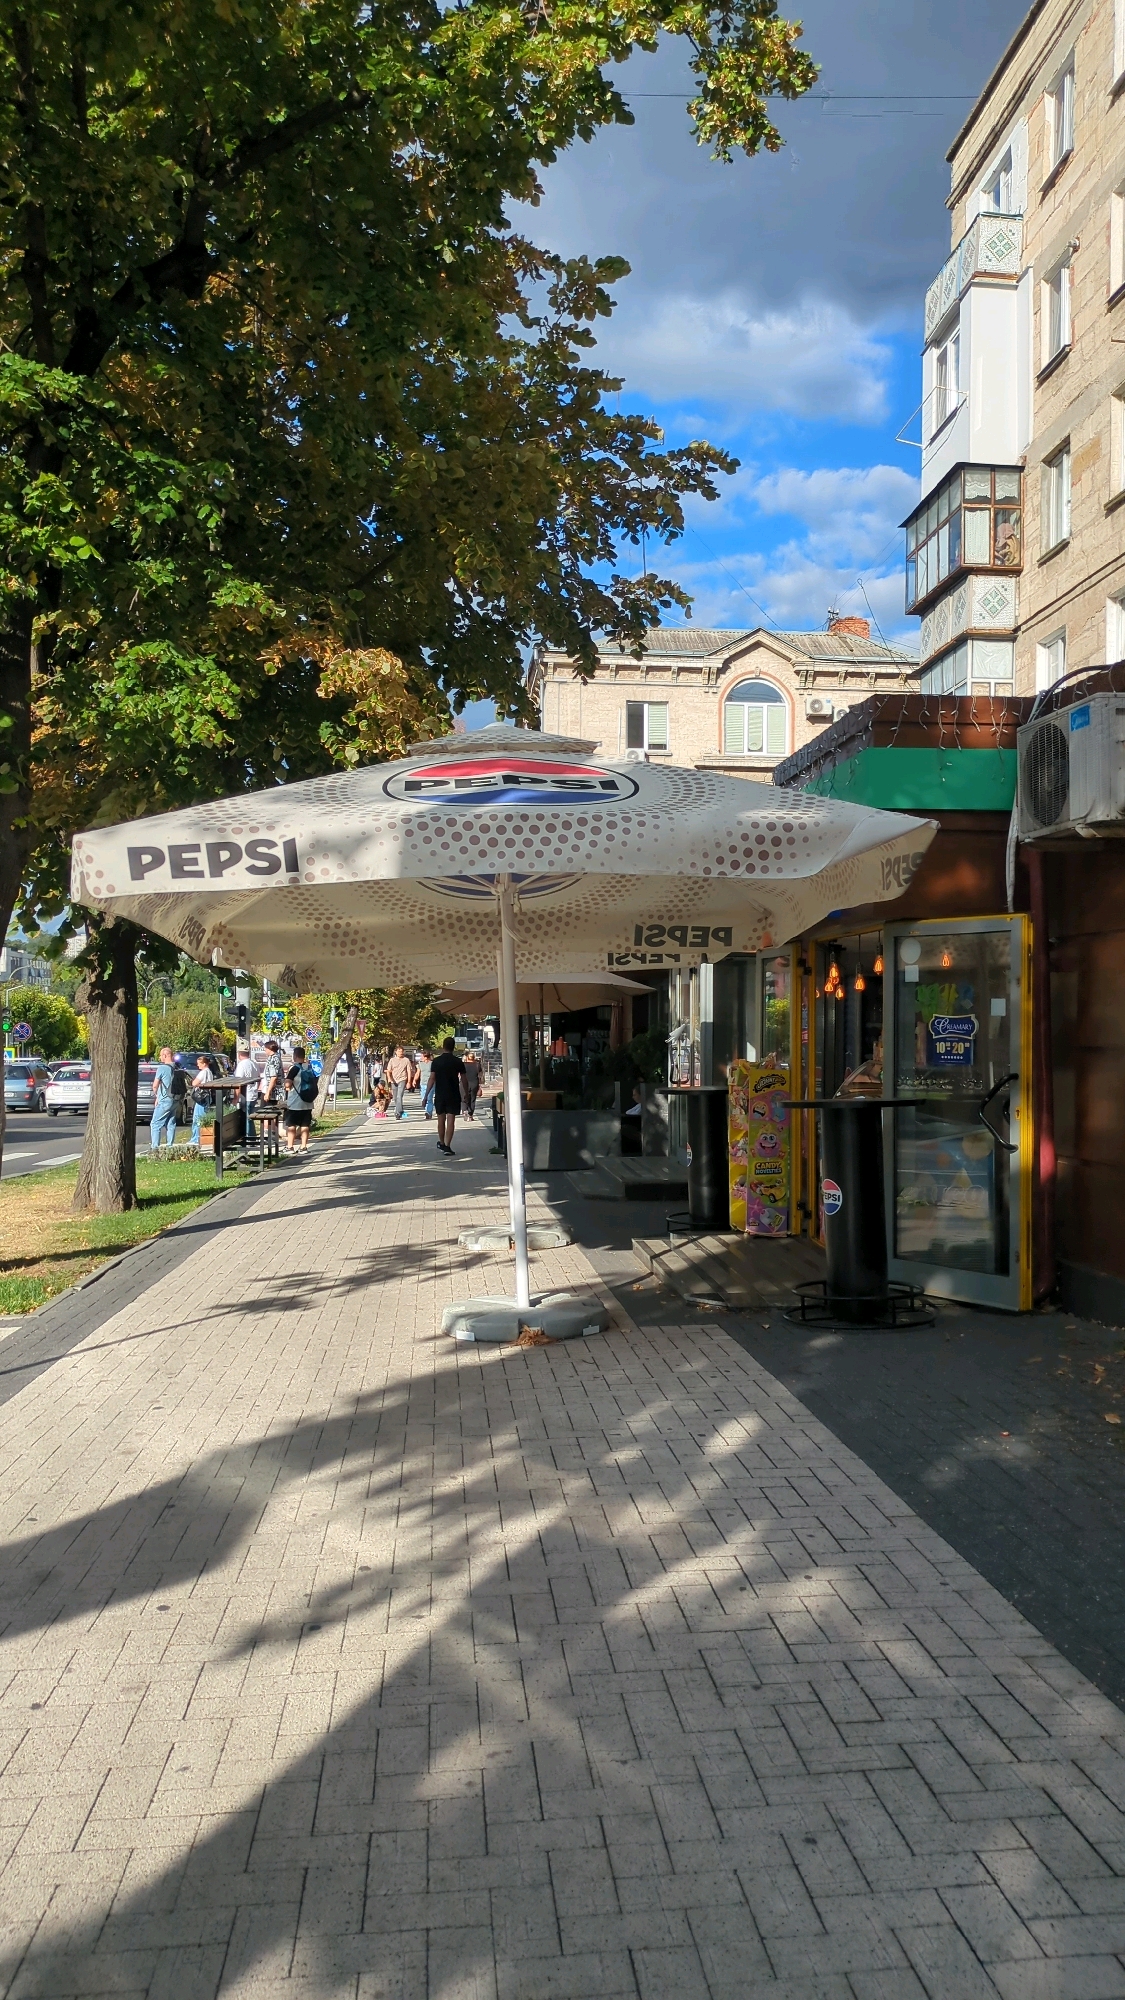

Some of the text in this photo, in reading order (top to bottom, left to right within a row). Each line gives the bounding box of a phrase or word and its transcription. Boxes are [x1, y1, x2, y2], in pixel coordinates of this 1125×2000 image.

[404, 774, 620, 791] PEPSI
[127, 837, 299, 881] PEPSI
[825, 1192, 840, 1202] EPSI
